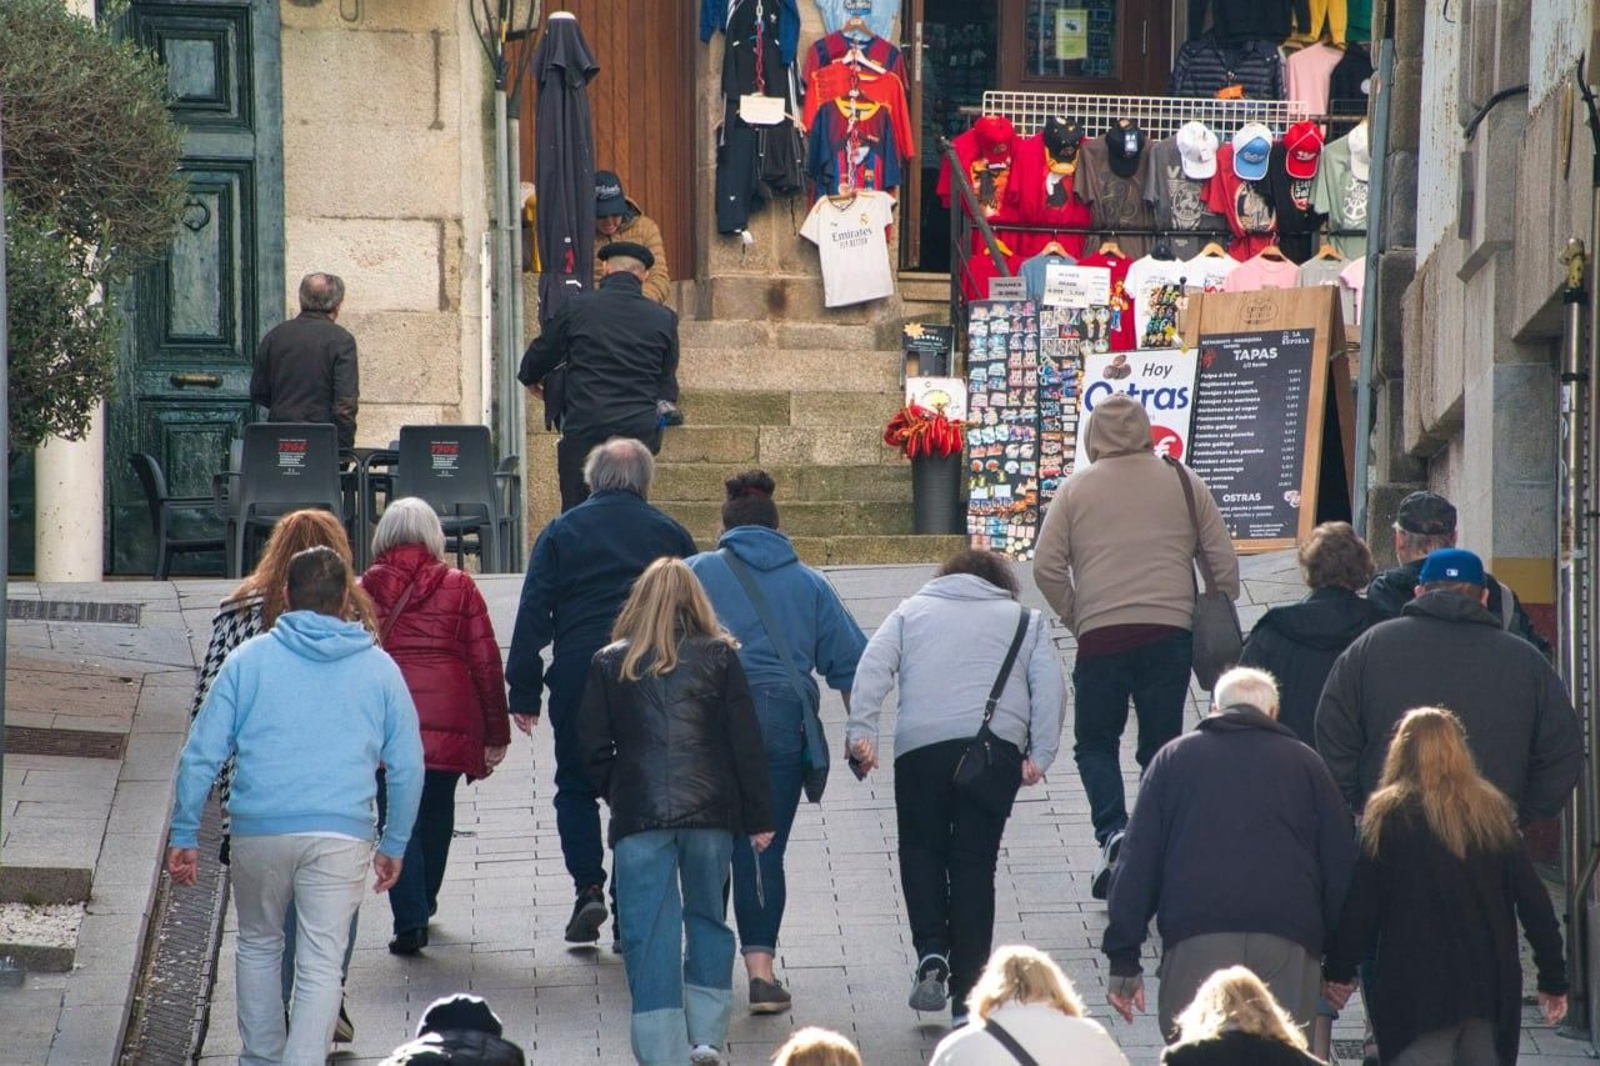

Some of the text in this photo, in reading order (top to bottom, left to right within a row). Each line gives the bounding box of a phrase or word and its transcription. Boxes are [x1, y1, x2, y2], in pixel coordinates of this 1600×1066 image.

[832, 228, 872, 242] Emirates
[1233, 348, 1278, 361] TAPAS
[1142, 362, 1173, 379] Hoy
[1084, 380, 1189, 413] Otras
[1223, 493, 1261, 502] OSTRAS
